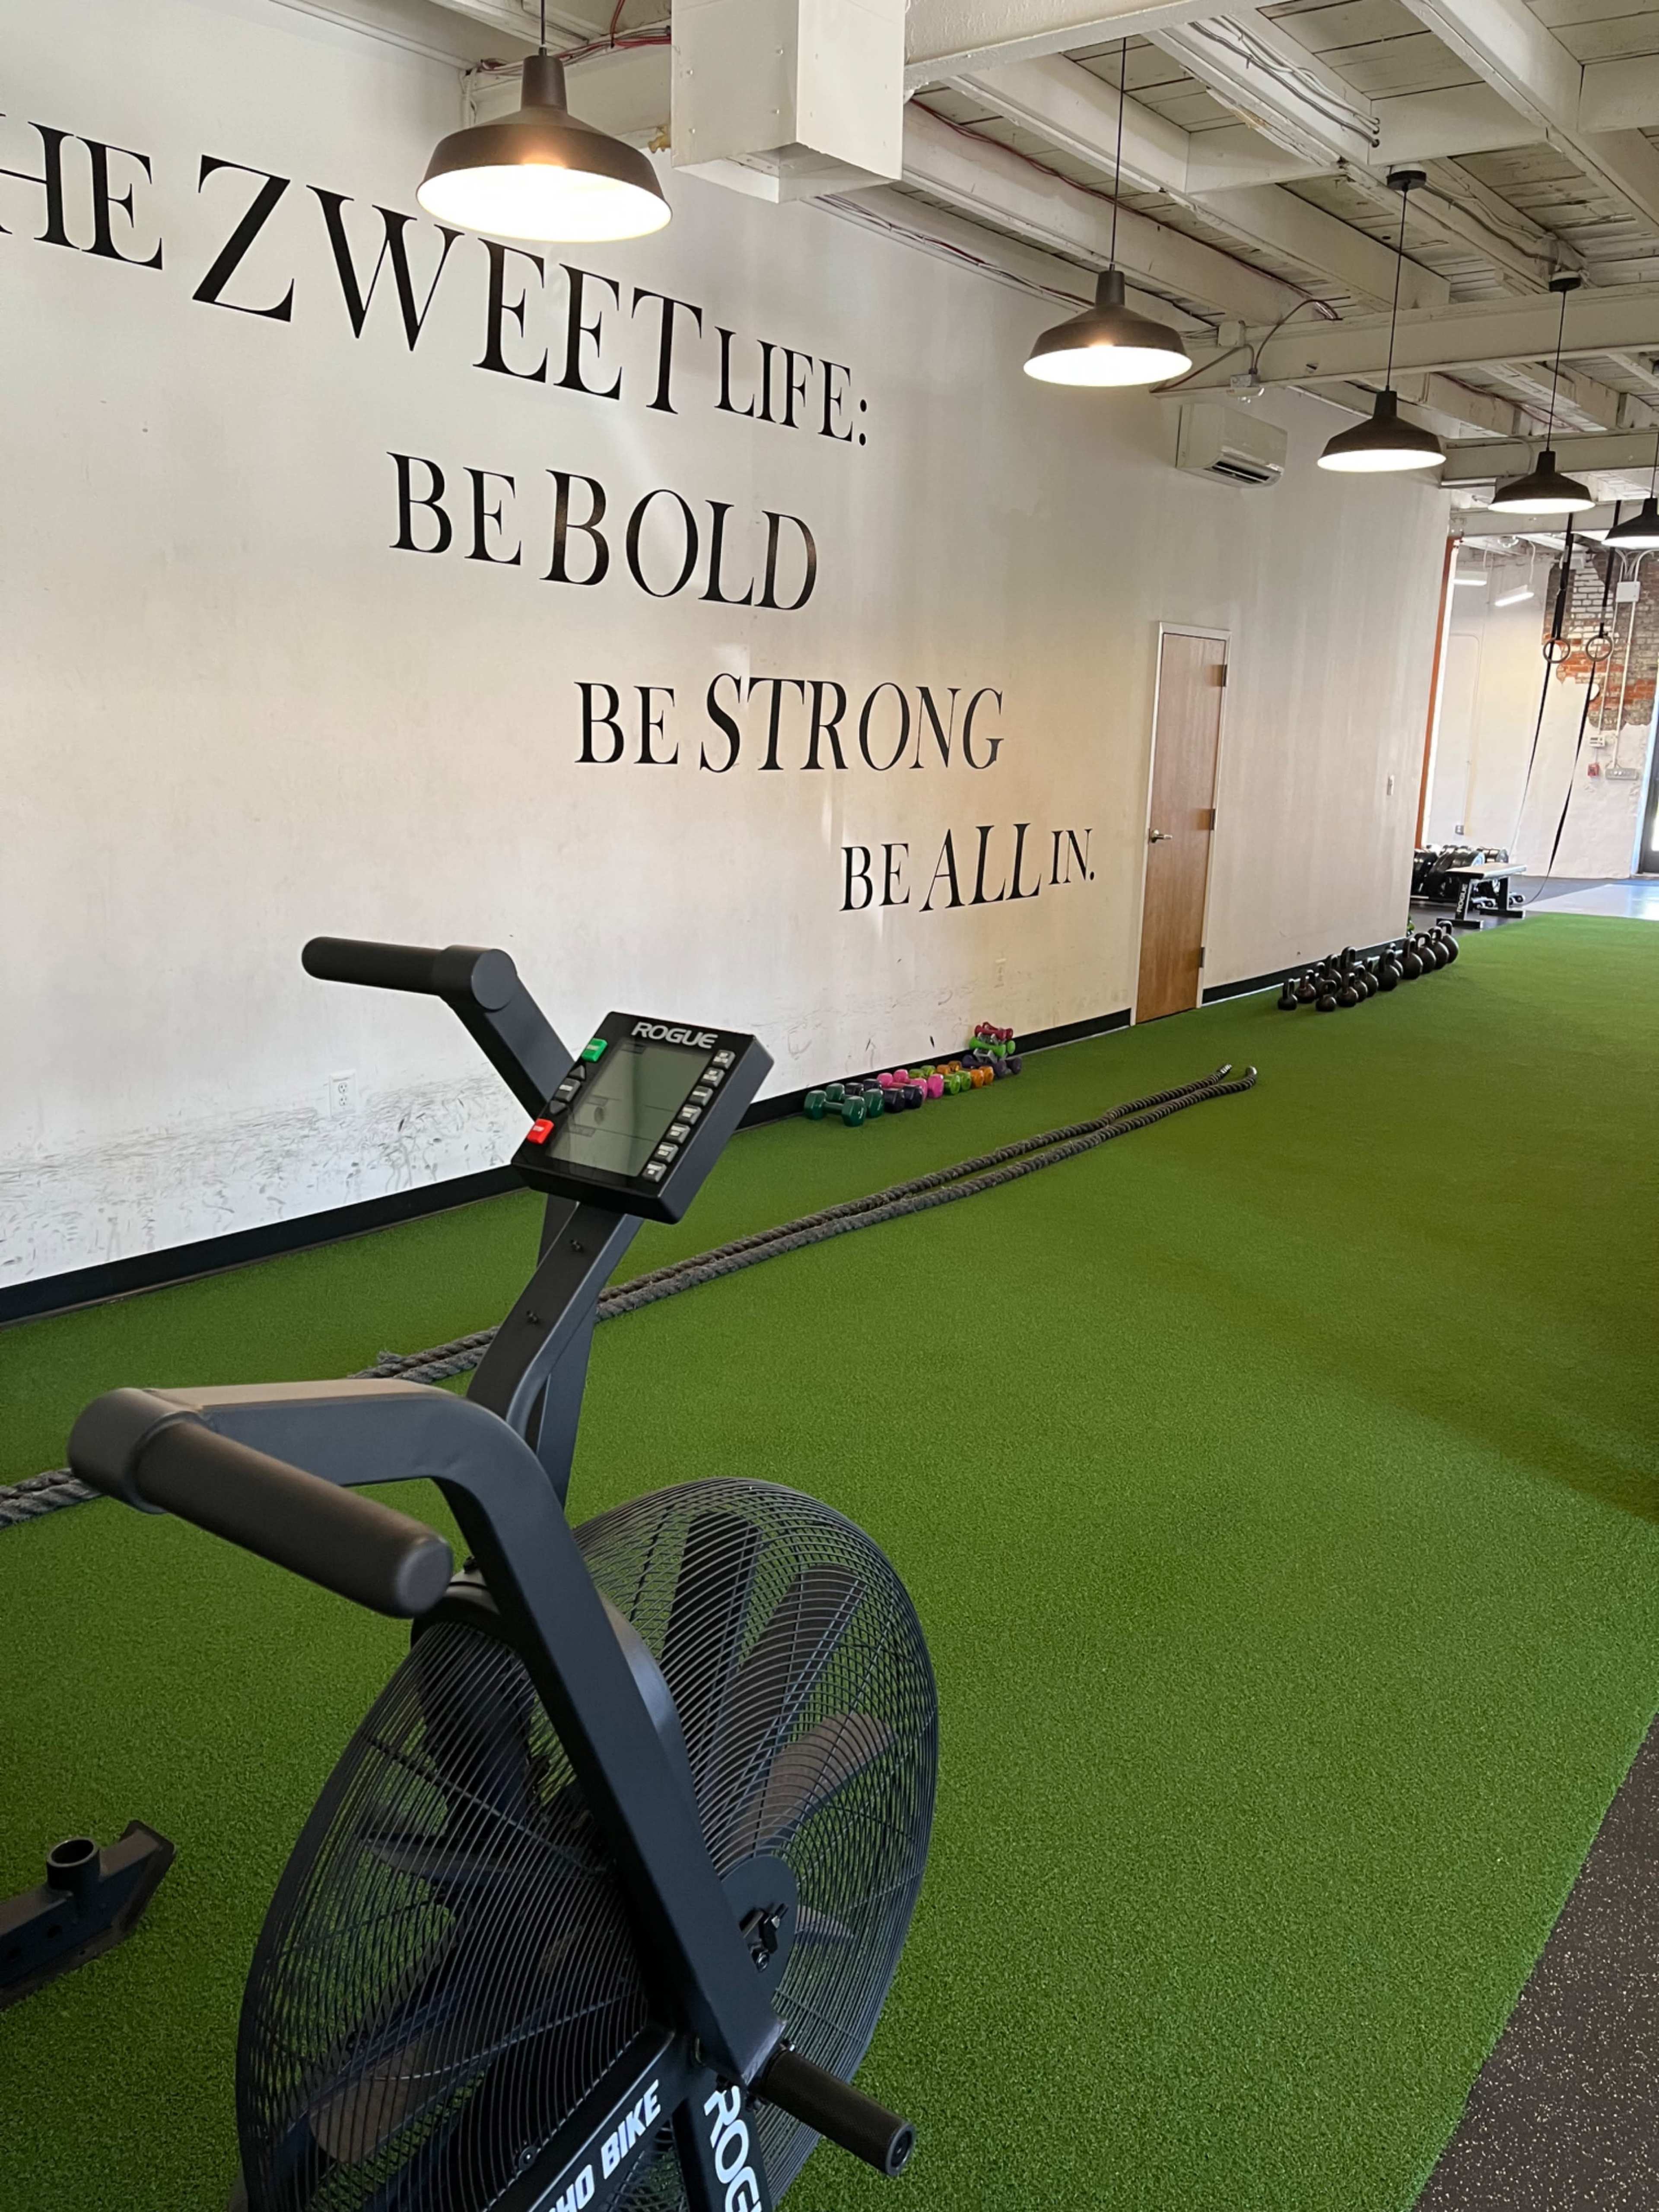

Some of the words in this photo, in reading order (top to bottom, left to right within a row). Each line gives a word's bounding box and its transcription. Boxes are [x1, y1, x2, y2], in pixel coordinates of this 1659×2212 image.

[192, 154, 702, 415] ZWEET
[714, 326, 868, 446] LIFE:
[386, 451, 521, 566] BE
[539, 469, 817, 611] BOLD
[574, 682, 679, 765] BE
[699, 673, 1004, 773] STRONG
[839, 843, 910, 912] BE
[918, 822, 1041, 912] ALL
[1049, 828, 1095, 885] IN.
[1456, 884, 1468, 913] ROGUE
[631, 1022, 718, 1049] ROGUE
[549, 2164, 595, 2212] HO
[601, 2079, 661, 2180] BIKE
[704, 2085, 762, 2212] ROG
